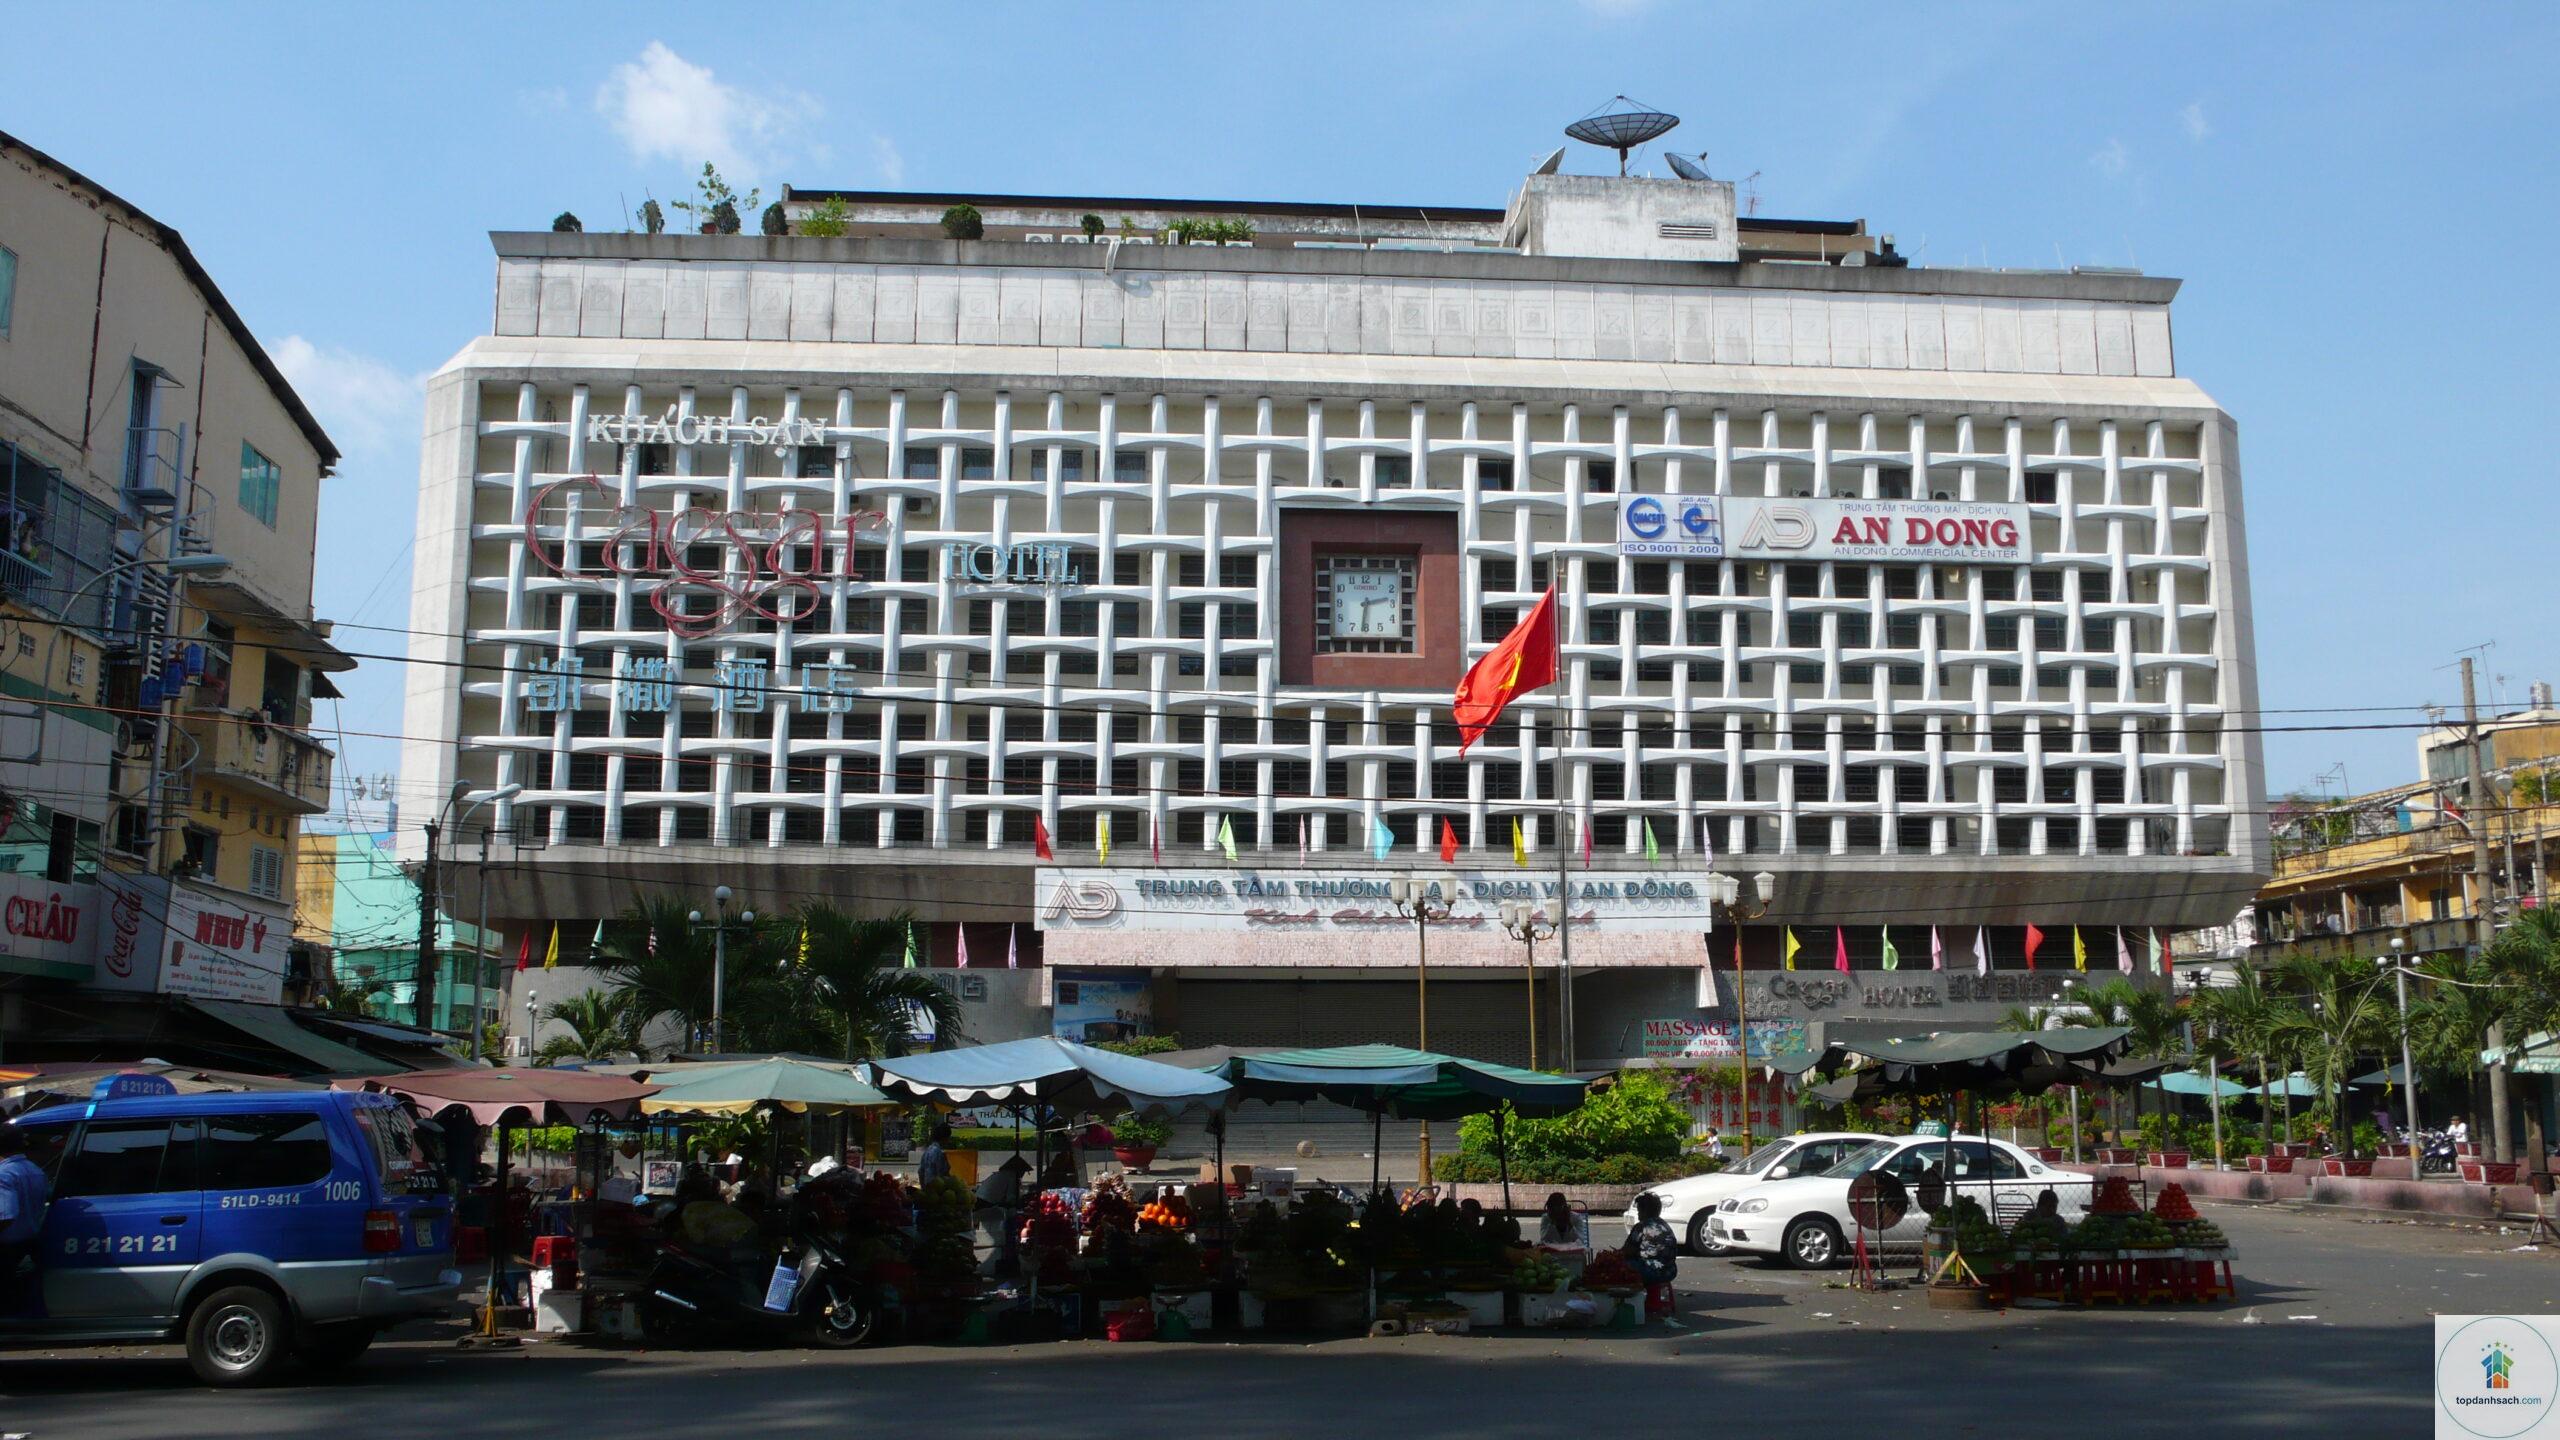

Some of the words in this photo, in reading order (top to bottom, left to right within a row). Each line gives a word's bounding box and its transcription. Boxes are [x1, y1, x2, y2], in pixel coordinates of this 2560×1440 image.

[1839, 503, 1872, 512] TRUNG
[1876, 503, 1896, 513] TÂM
[1832, 516, 1890, 545] AN
[1905, 517, 2019, 547] DONG
[1624, 544, 1647, 552] ISO
[1650, 544, 1678, 553] 9001
[1689, 545, 1719, 554] 2000
[1834, 547, 1849, 555] AN
[1853, 547, 1887, 556] DONG
[1891, 547, 1967, 557] COMMERCIAL
[1971, 549, 2019, 558] CENTER
[943, 543, 1078, 584] HOTEL
[1135, 879, 1223, 897] TRUNG
[1232, 876, 1292, 897] TÂM
[1581, 881, 1616, 898] AN
[1624, 877, 1695, 898] ĐÔNG
[5, 892, 81, 944] CHÂU
[195, 910, 250, 950] NHƯ
[252, 915, 267, 954] Ý
[1646, 1021, 1733, 1036] MASSAGE
[130, 1080, 141, 1092] 21
[143, 1081, 154, 1094] 21
[155, 1083, 166, 1095] 21
[221, 1193, 301, 1208] 51LD-9414
[324, 1181, 361, 1201] 1006
[64, 1238, 78, 1254] 8
[86, 1237, 111, 1253] 21
[119, 1235, 144, 1253] 21
[151, 1235, 177, 1252] 21
